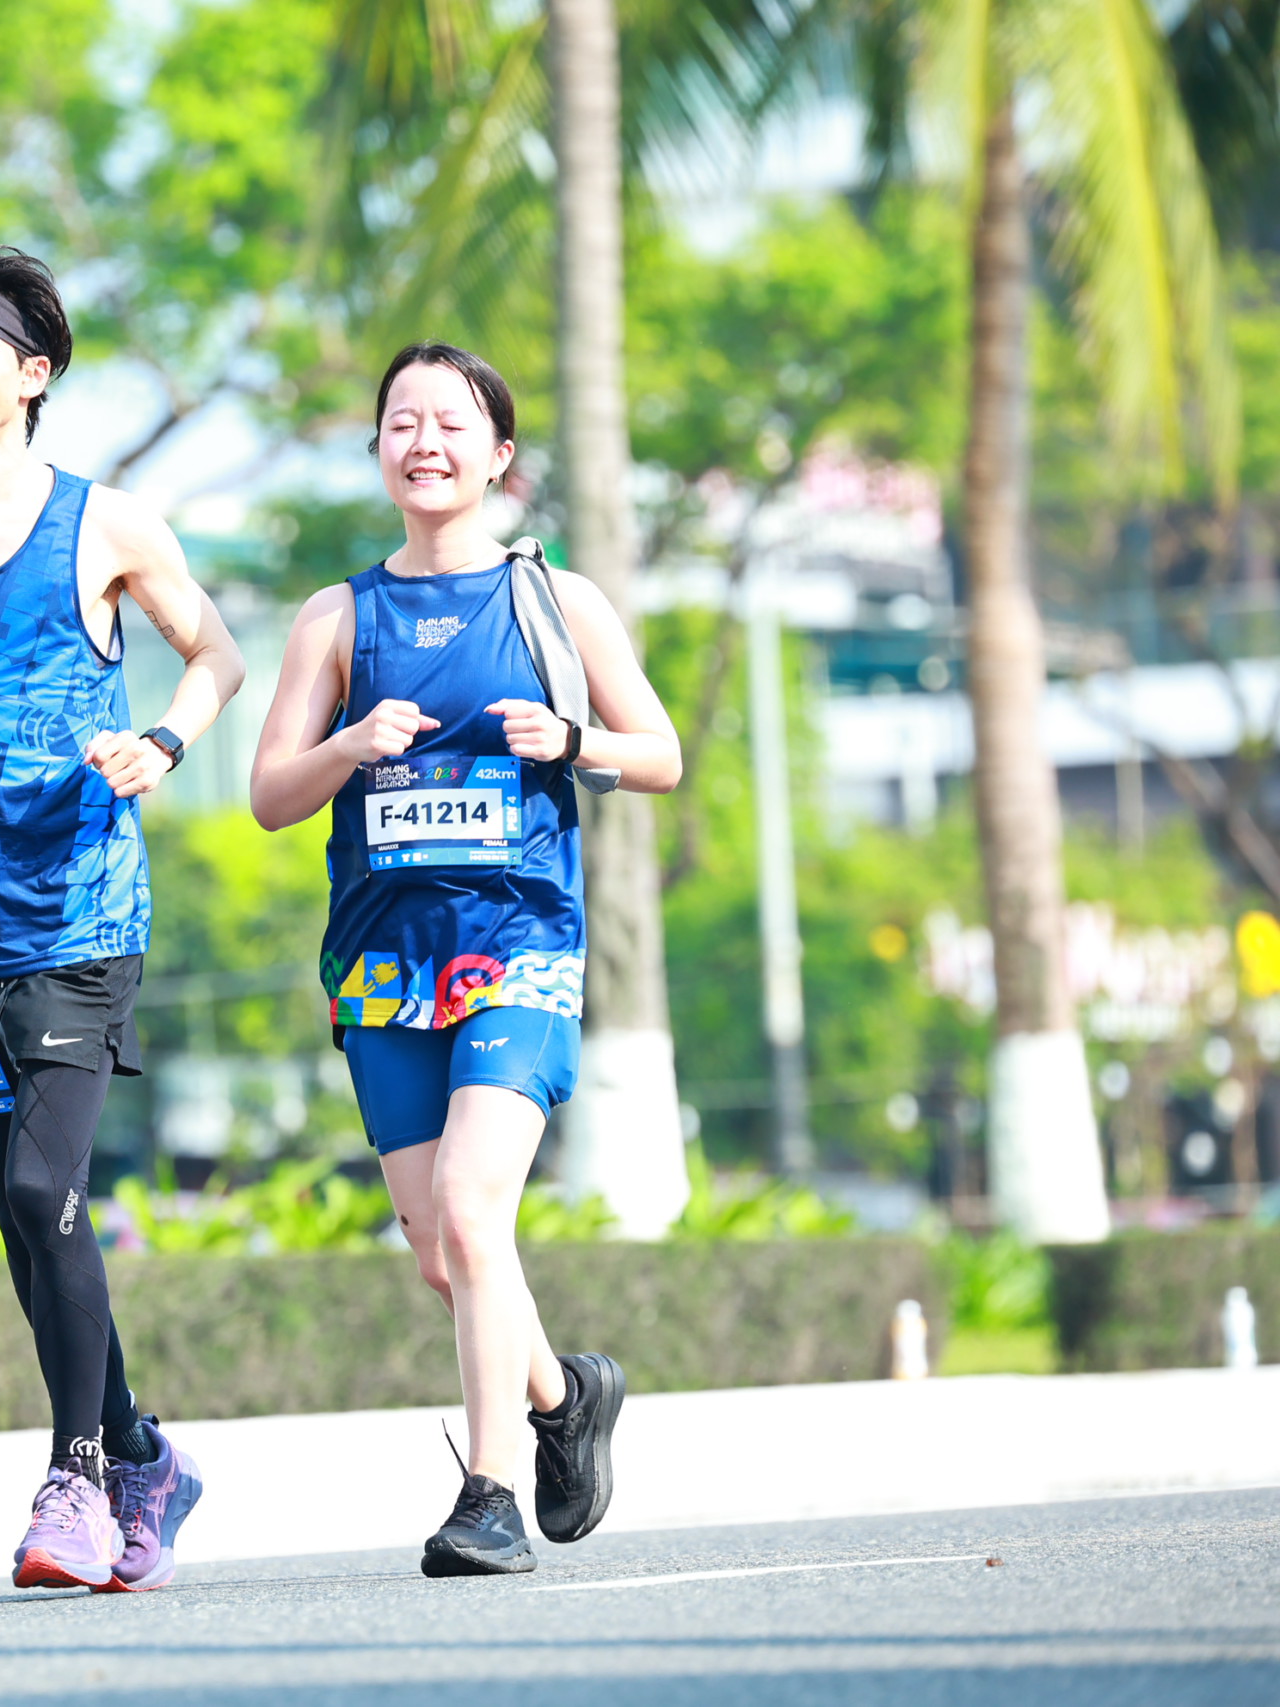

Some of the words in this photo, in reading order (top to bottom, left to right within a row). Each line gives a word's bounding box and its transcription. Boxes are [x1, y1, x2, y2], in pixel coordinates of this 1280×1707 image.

[417, 616, 459, 627] DANANG
[414, 636, 449, 648] 2025
[376, 764, 410, 776] DANANG
[424, 767, 460, 780] 2025
[476, 768, 516, 780] 42km
[376, 772, 420, 783] INTERNATIONAL
[376, 780, 410, 790] MARATHON
[506, 795, 517, 804] 4
[380, 801, 488, 829] F-41214
[507, 806, 518, 832] PEN
